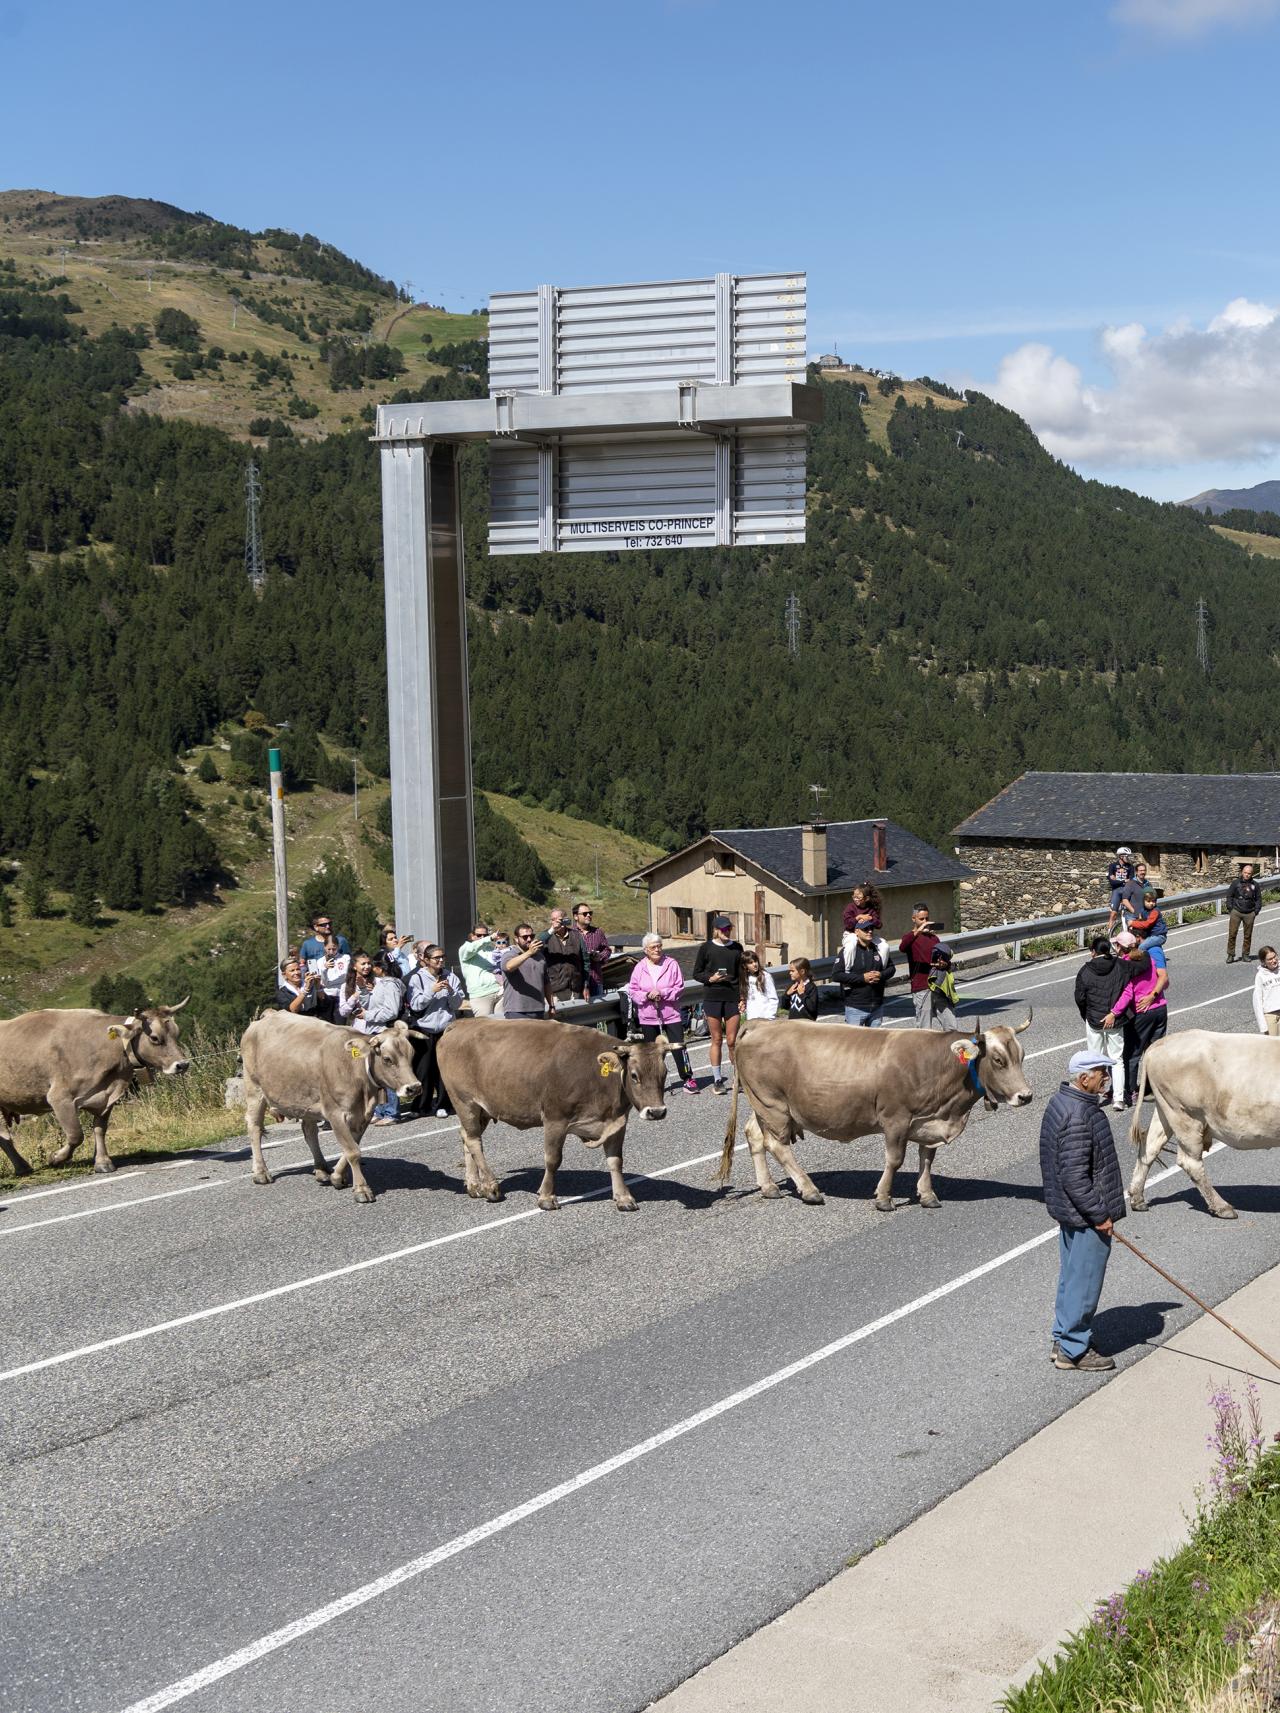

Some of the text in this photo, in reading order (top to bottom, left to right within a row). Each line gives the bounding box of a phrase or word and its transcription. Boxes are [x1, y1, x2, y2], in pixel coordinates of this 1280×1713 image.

[570, 517, 714, 534] MULTISERVEIS CO-PRINCEP
[624, 534, 683, 548] Tel: 732 640
[1262, 979, 1273, 987] NEW
